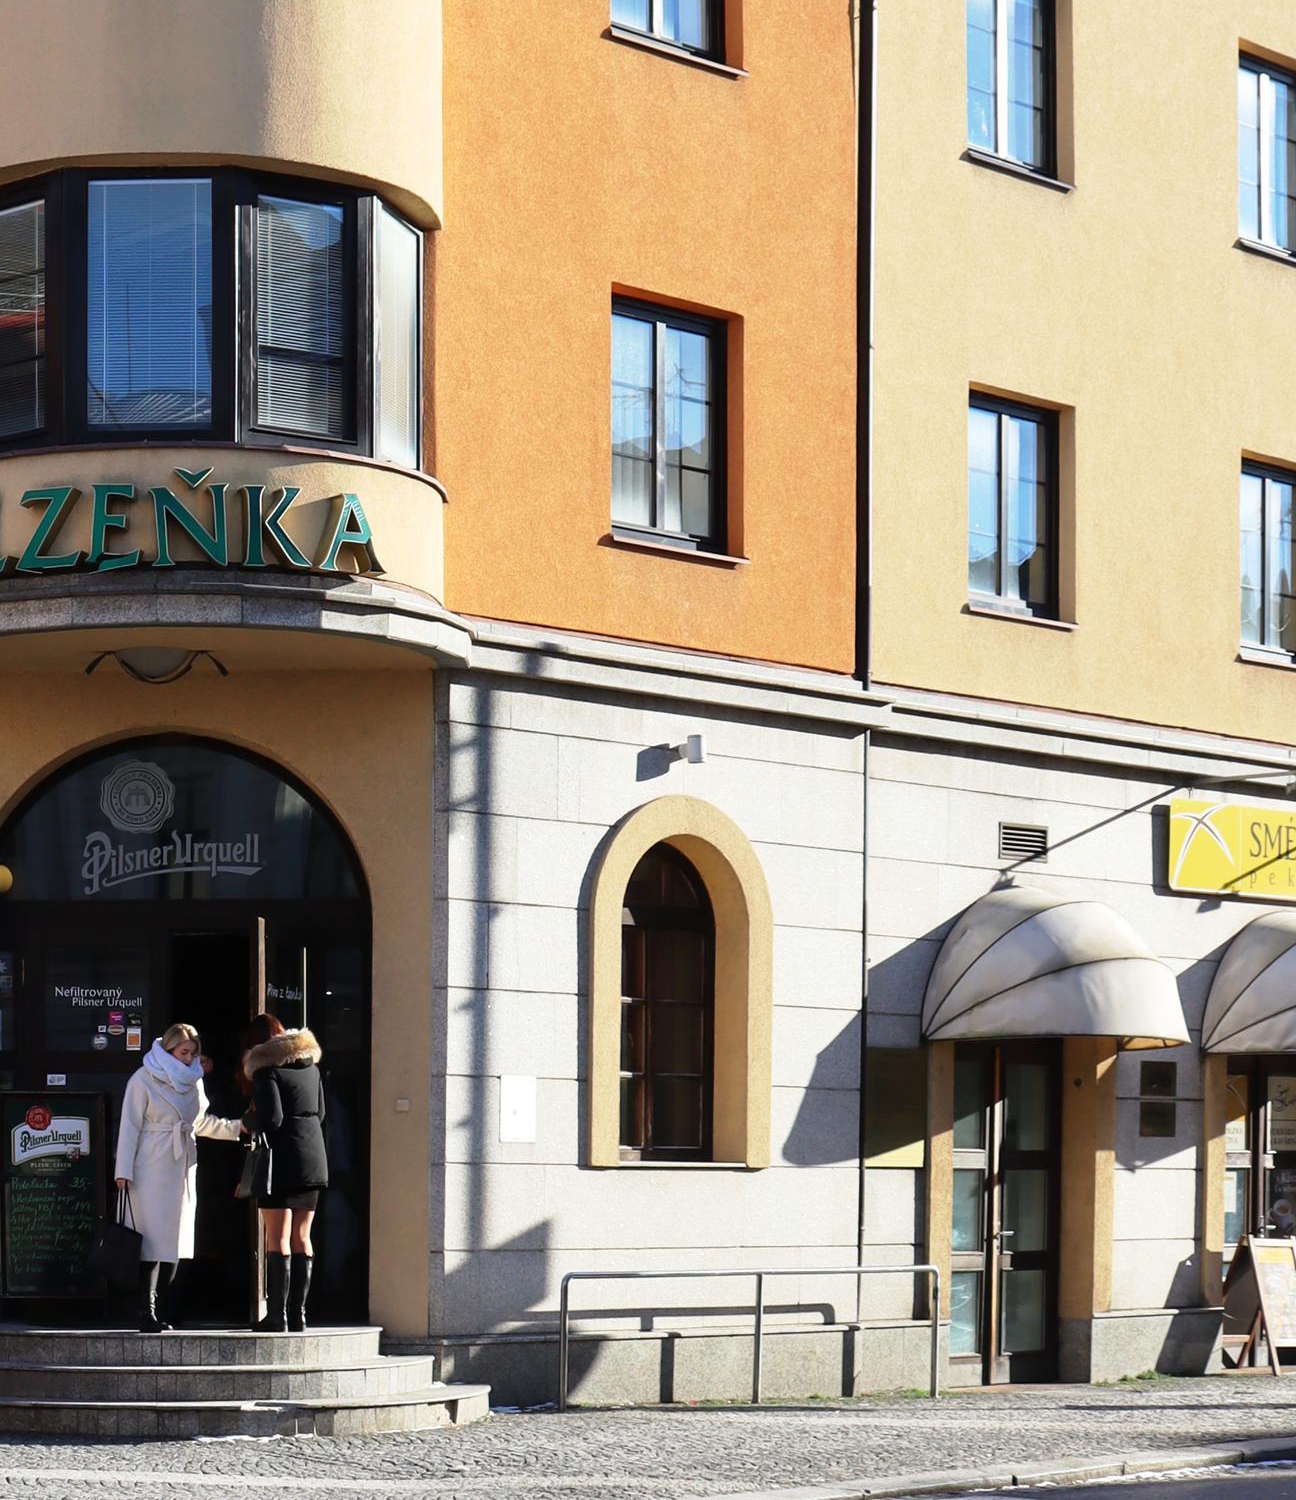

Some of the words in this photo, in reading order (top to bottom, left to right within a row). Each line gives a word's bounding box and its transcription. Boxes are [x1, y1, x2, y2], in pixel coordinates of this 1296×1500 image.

[81, 831, 173, 895] Pilsner
[171, 829, 260, 878] Urquell
[54, 986, 123, 999] Nefiltrovaný
[72, 997, 104, 1007] Pilsner
[107, 997, 143, 1008] Urquell
[20, 1130, 51, 1154] Pilsner
[51, 1130, 82, 1145] Urquell
